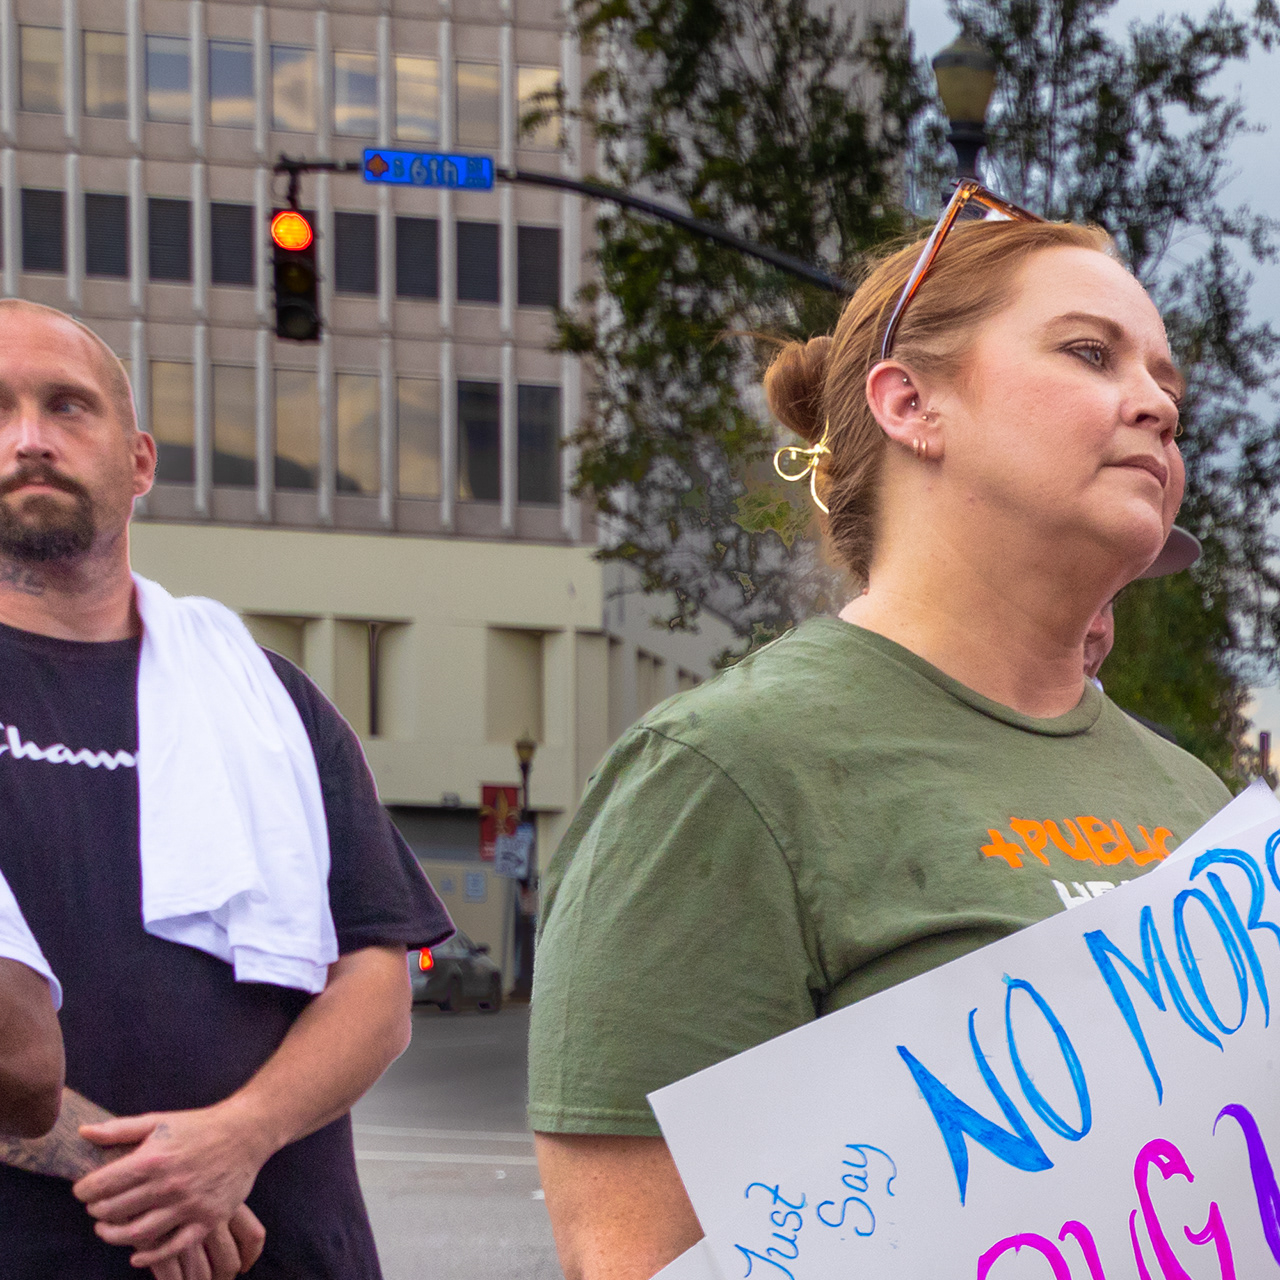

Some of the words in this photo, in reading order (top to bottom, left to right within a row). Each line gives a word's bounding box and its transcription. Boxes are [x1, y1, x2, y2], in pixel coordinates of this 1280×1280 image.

[409, 156, 459, 188] 6th
[896, 972, 1094, 1206] NO
[816, 1143, 898, 1237] Say
